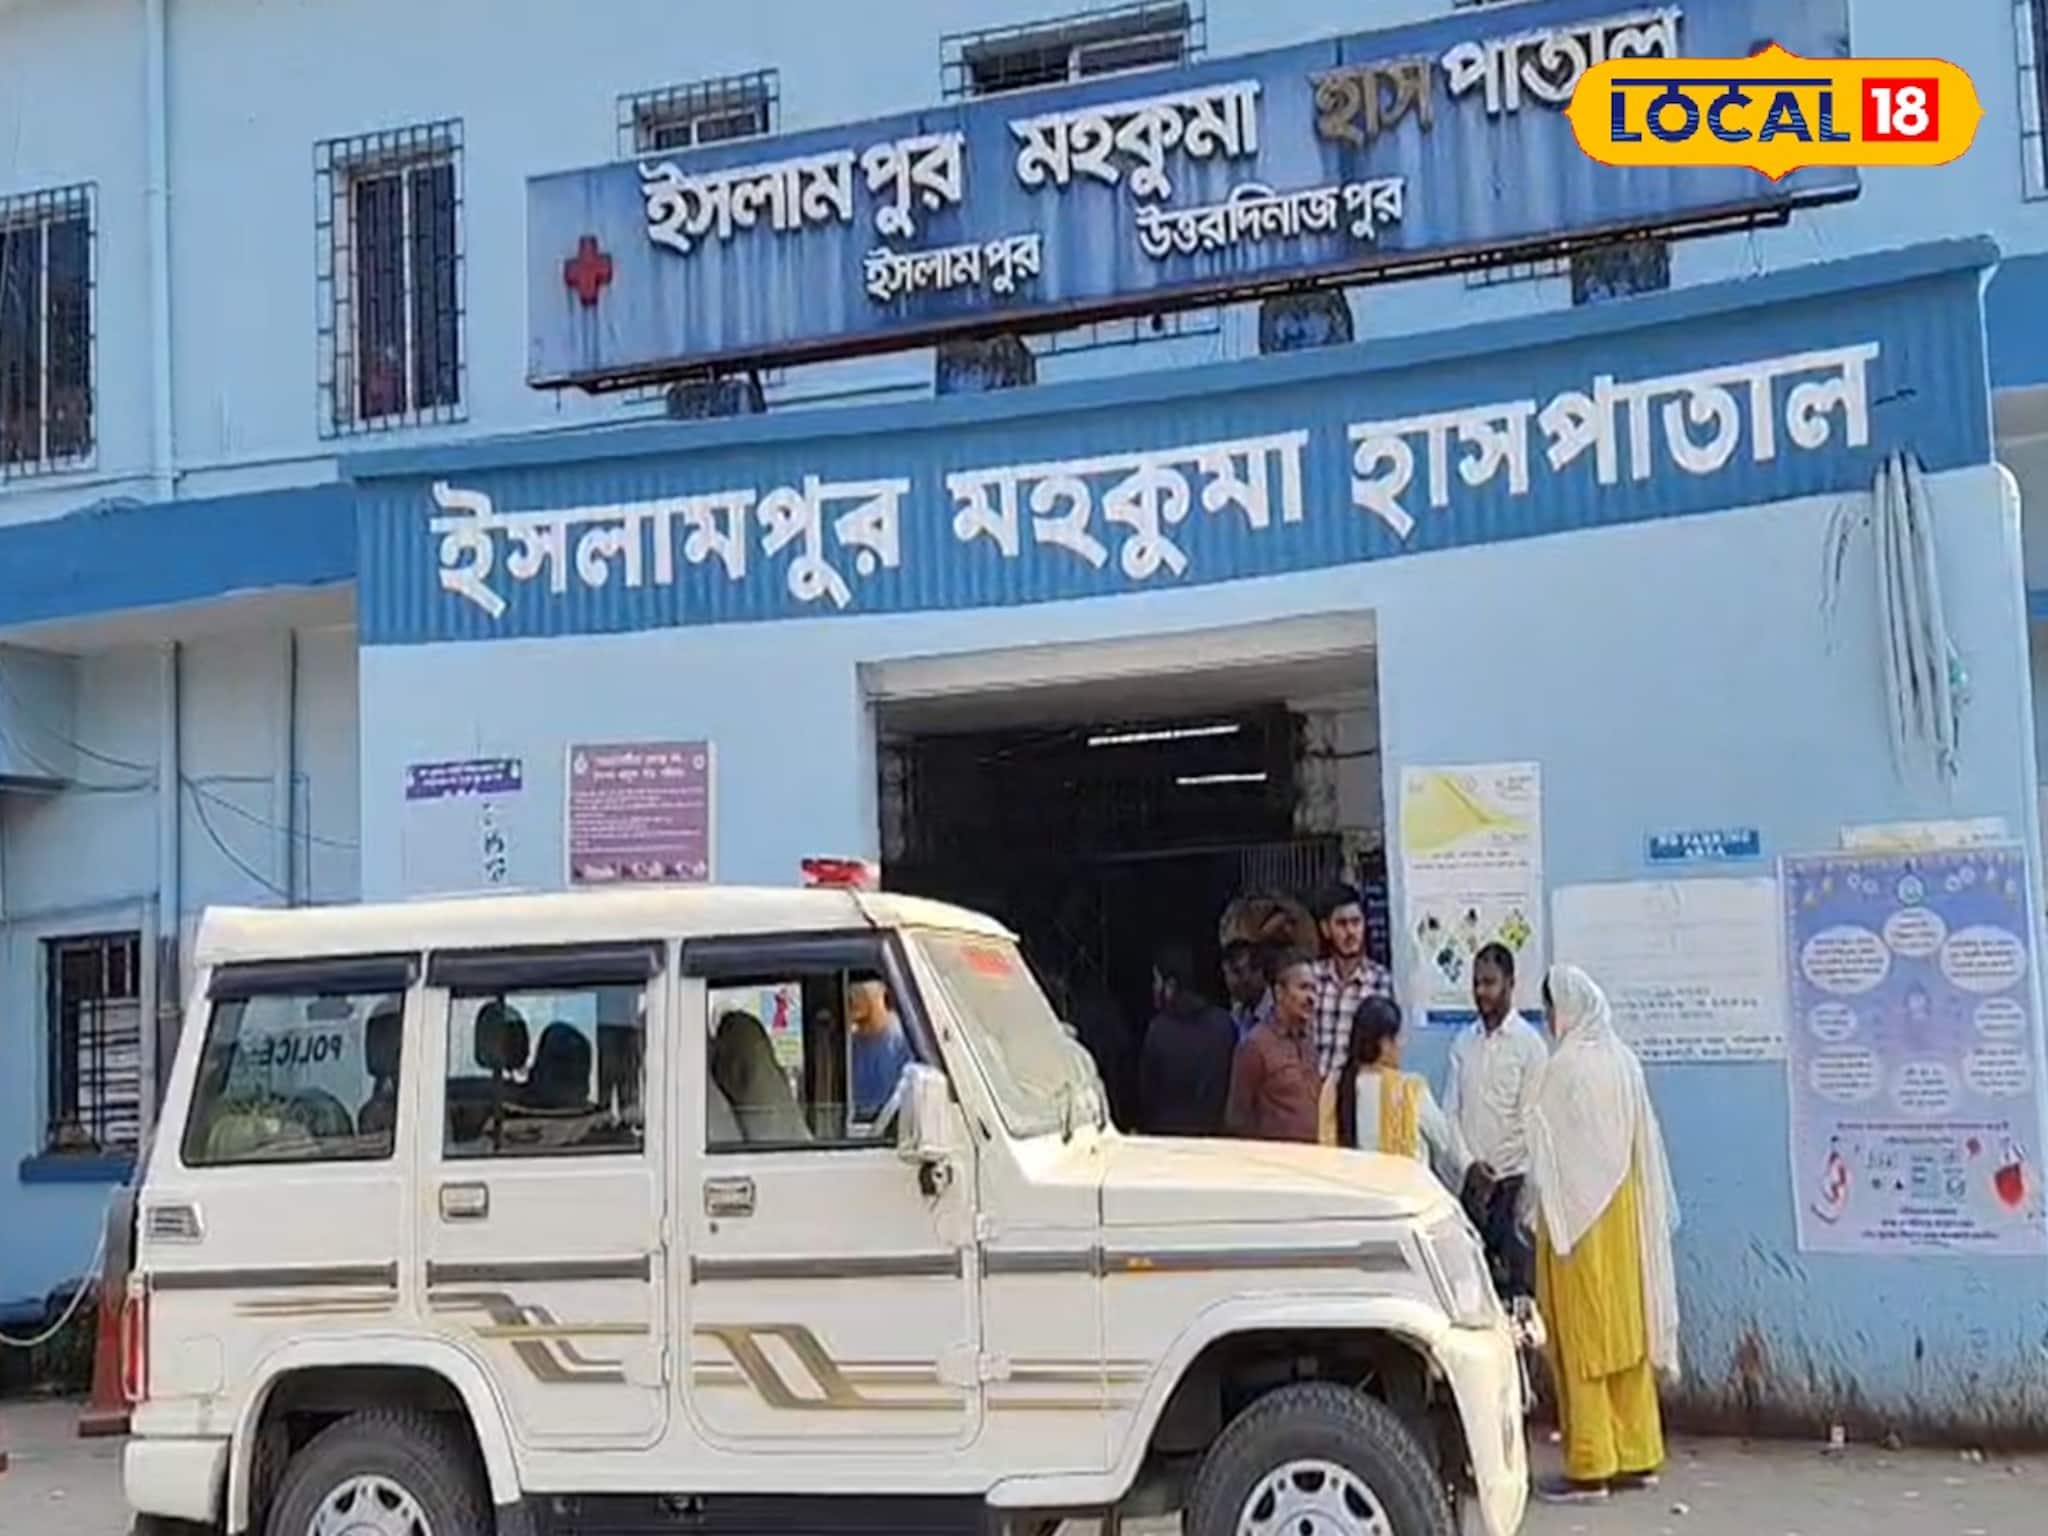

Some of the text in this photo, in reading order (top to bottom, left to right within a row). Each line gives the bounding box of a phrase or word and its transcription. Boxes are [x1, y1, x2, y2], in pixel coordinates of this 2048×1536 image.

[1009, 79, 1262, 199] মহকুমা
[430, 341, 1880, 617] ইসলামপুর মহকুমা হাসপাতাল
